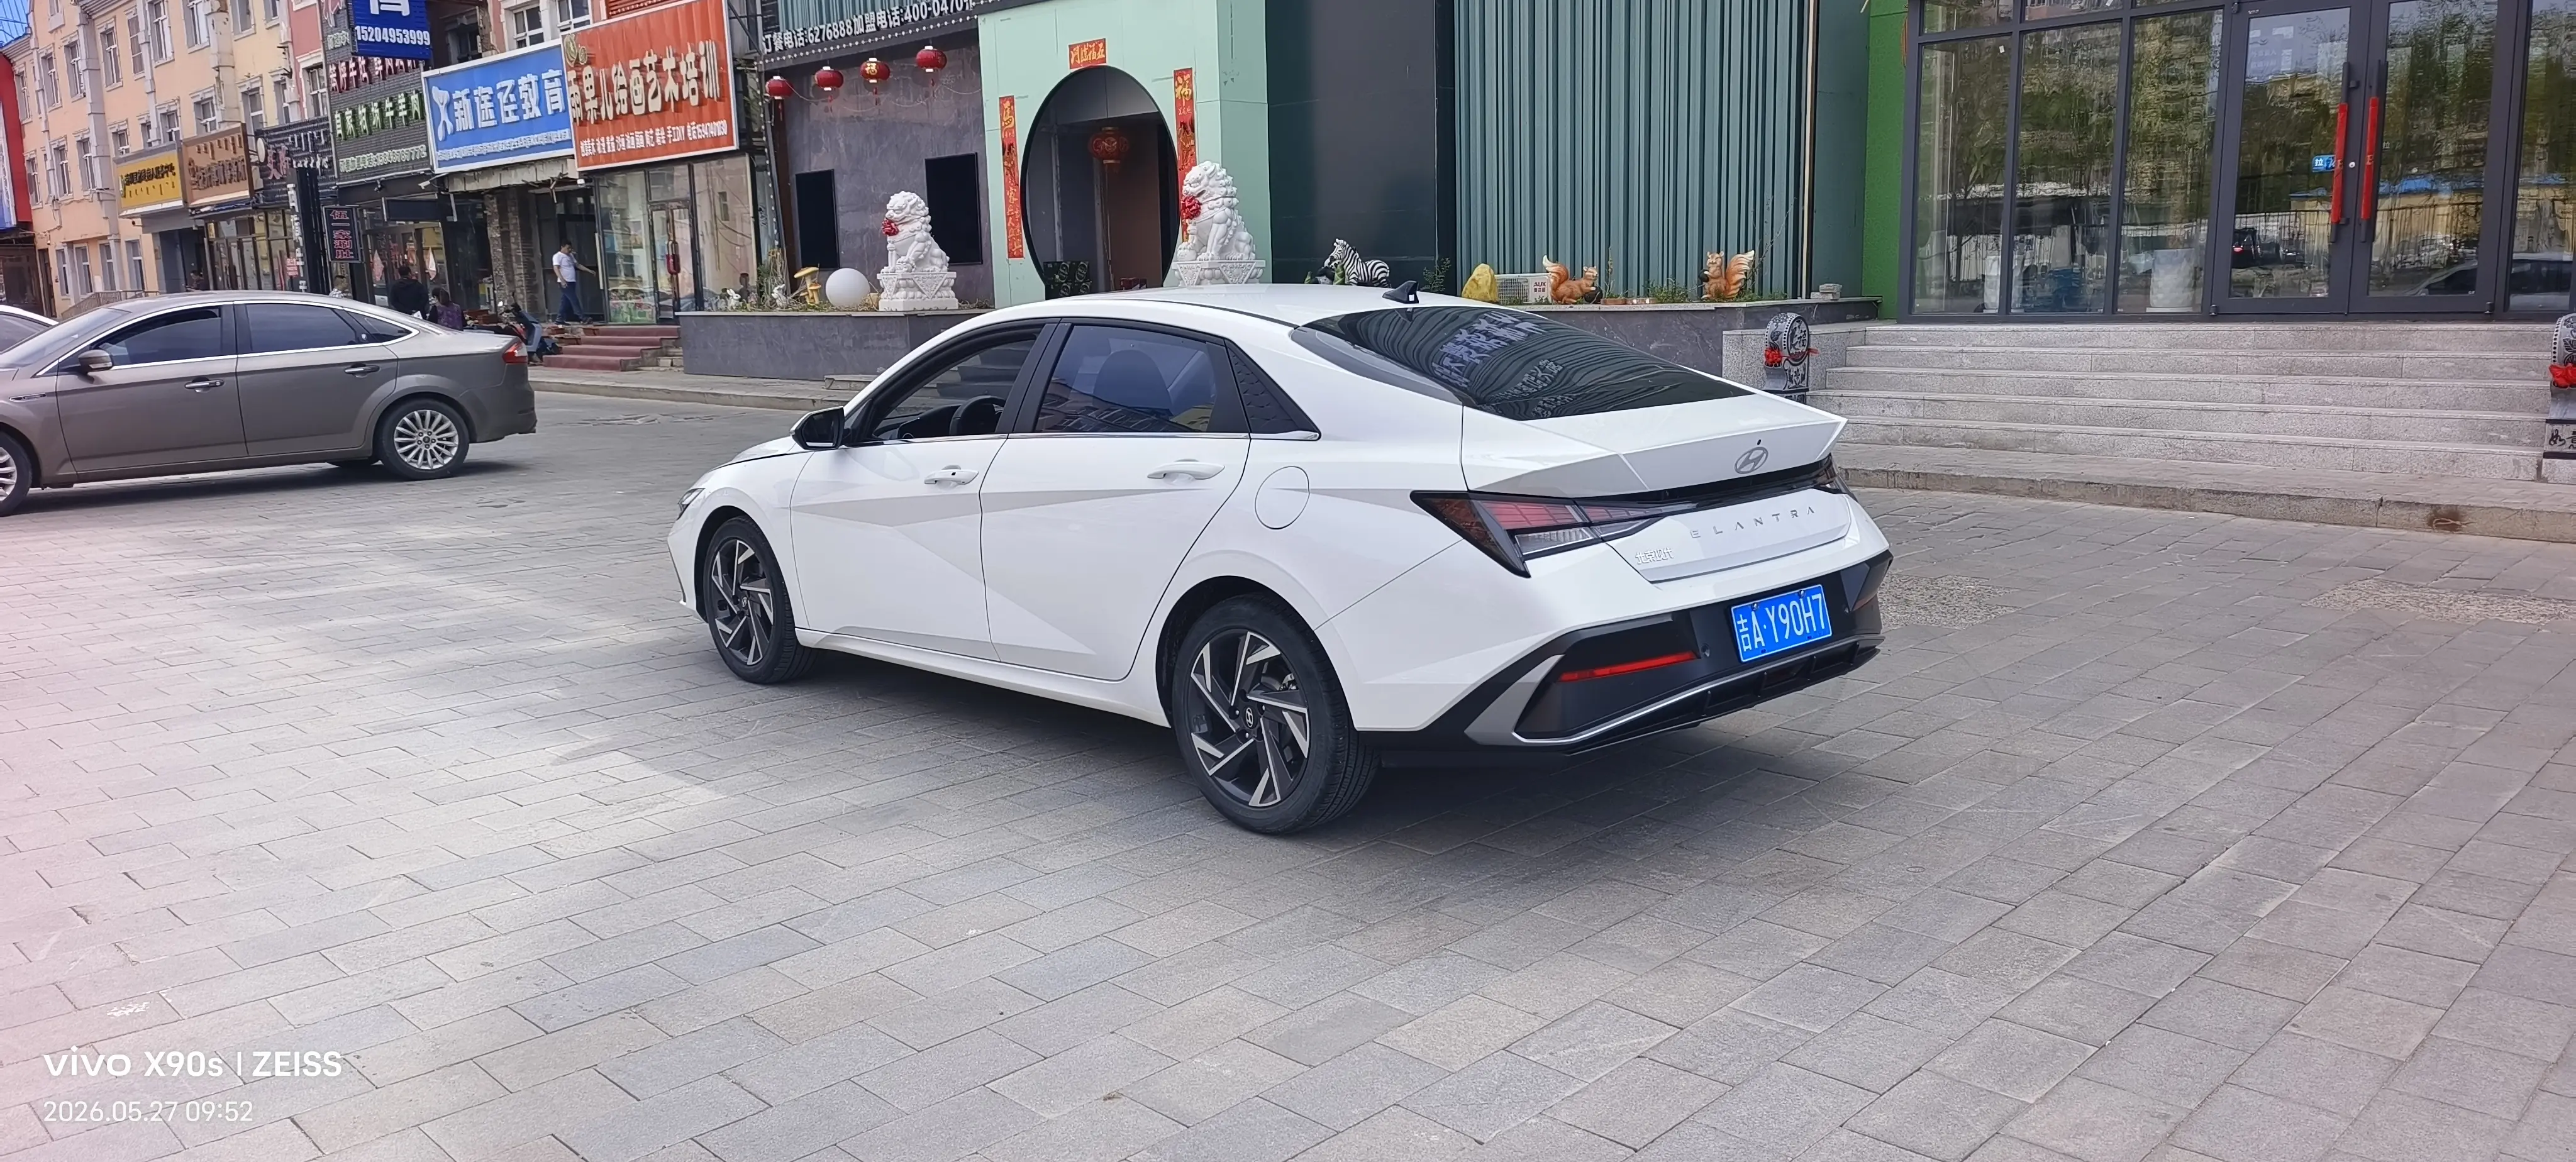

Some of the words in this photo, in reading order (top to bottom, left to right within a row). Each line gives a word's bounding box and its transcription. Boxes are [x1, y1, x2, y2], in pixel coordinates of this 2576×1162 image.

[354, 26, 431, 45] 15204953999
[335, 89, 421, 140] 自家牧场牛羊肉
[452, 69, 565, 131] 新途径教育
[2314, 158, 2324, 167] 拉
[330, 209, 355, 259] 伍一家涮肚
[1690, 506, 1815, 539] ELANTRA
[1635, 547, 1674, 565] 北京现代
